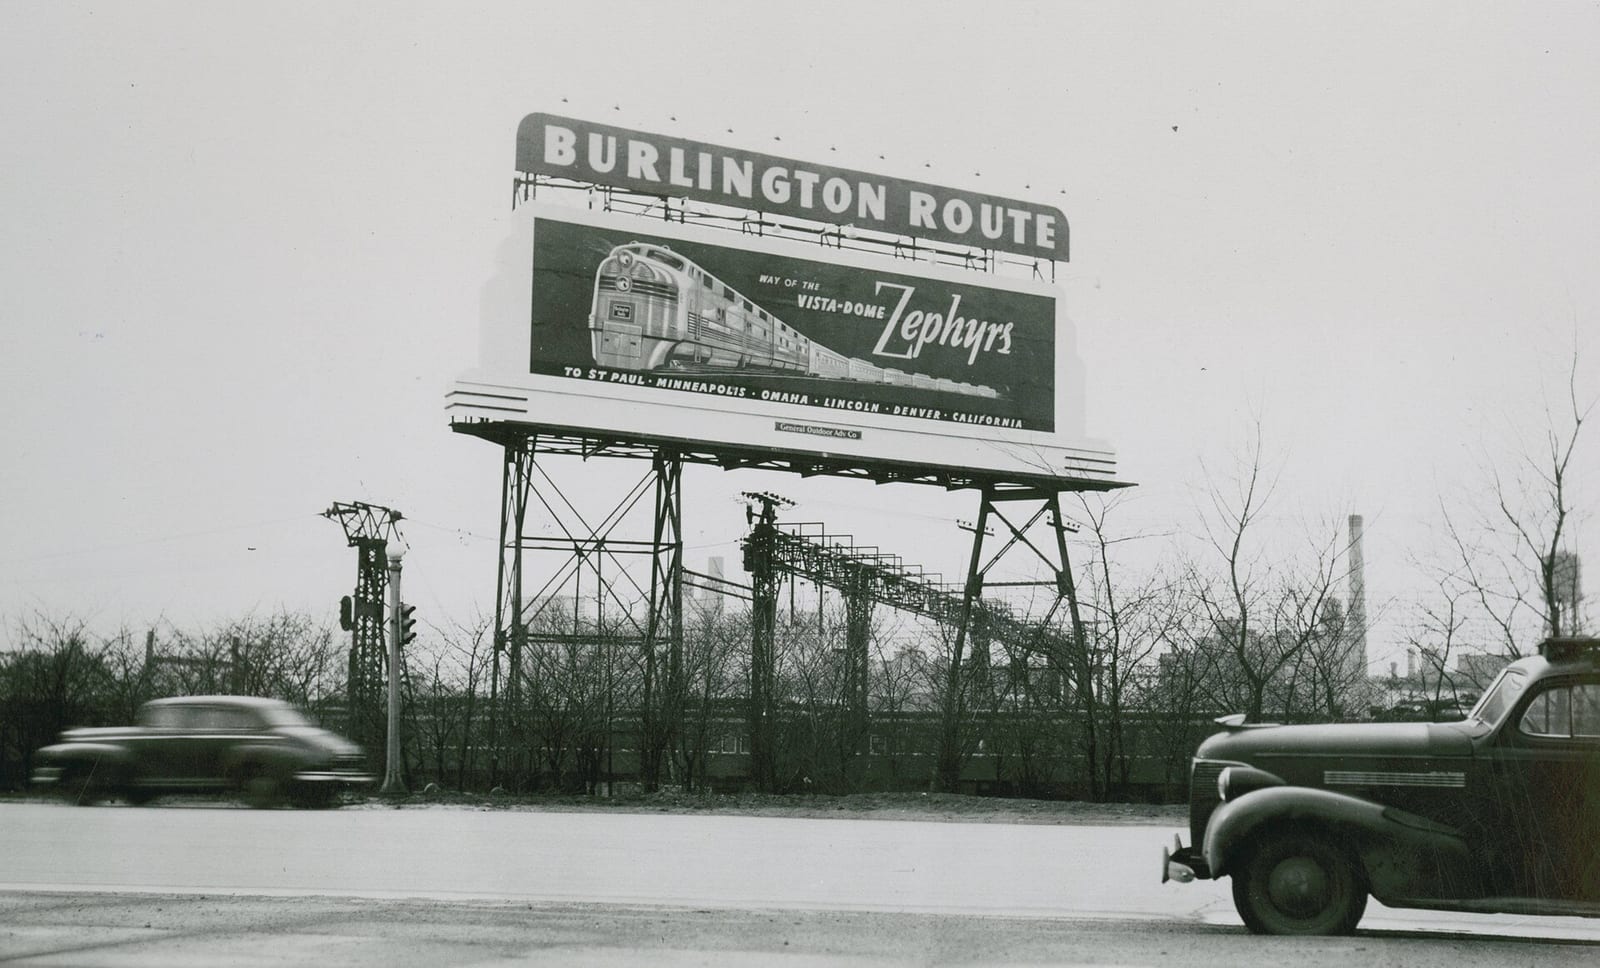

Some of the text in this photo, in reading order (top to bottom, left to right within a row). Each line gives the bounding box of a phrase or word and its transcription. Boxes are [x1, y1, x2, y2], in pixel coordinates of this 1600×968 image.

[543, 124, 1057, 250] BURLINGTON ROUTE
[759, 274, 820, 291] WAY OF THE
[797, 294, 886, 319] VISTA-DOME
[872, 281, 1014, 365] Zephyrs
[564, 367, 1023, 429] TO ST PAUL MINNEAPOLIS OMAHA LINCOLN DENVER CALIFORNIA
[779, 423, 806, 432] General
[807, 426, 833, 436] Outdoor
